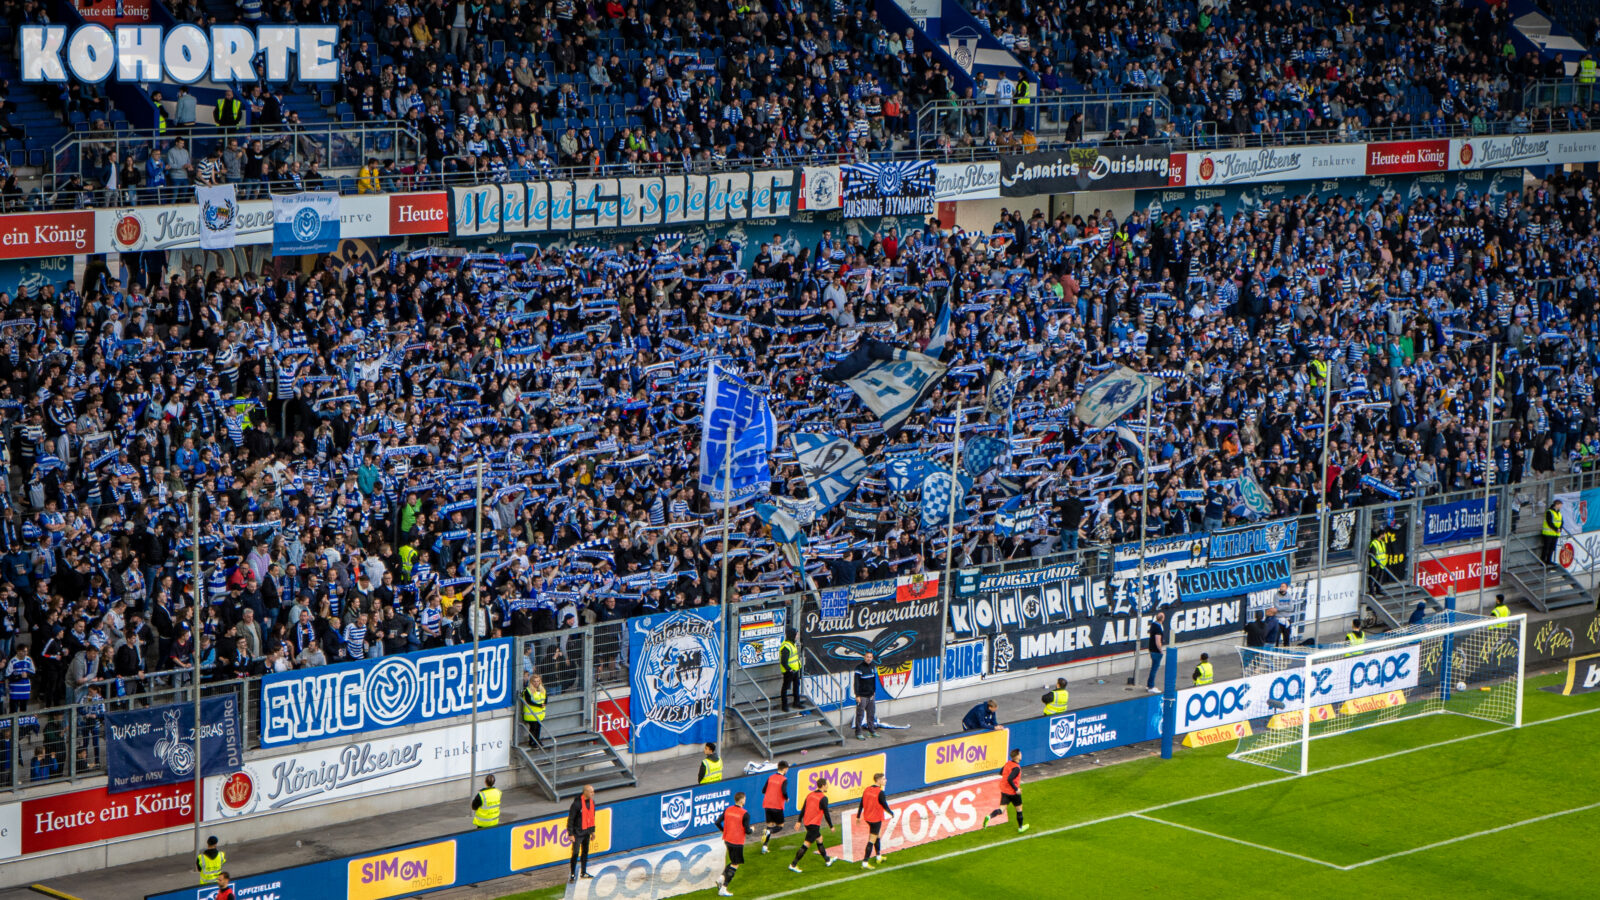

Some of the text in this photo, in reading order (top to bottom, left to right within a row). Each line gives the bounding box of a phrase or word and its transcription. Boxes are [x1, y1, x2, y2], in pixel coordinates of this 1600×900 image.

[1371, 148, 1445, 167] Heute ein König
[1558, 142, 1598, 154] Fankurve
[1002, 155, 1170, 187] Fanatics Duisburg
[1311, 155, 1356, 168] Fankurve
[398, 204, 443, 223] Heute
[885, 195, 934, 216] DYNAMITES
[2, 225, 87, 250] ein König
[1428, 512, 1453, 535] Block
[1177, 556, 1291, 597] WEDAUSTADION
[1416, 570, 1448, 587] Heute
[1449, 566, 1465, 582] ein
[951, 579, 1109, 634] KOHORTE
[1309, 589, 1356, 605] Fnkurve
[805, 600, 939, 633] Proud Generation
[1169, 600, 1241, 634] GEBEN!
[1020, 625, 1093, 660] IMMER
[1349, 652, 1411, 694] pape
[263, 642, 511, 744] EWIG TREU
[1185, 683, 1252, 728] pape
[1353, 697, 1387, 715] Sinalco
[1077, 713, 1107, 725] OFFIZIELLER
[224, 699, 238, 767] DUISBURG
[1076, 730, 1117, 748] PARTNER
[1077, 724, 1106, 738] TEAM-
[1196, 729, 1232, 747] Sinalco
[114, 771, 164, 787] Nur der MSV
[694, 789, 730, 803] OFFIZIELLER
[35, 804, 95, 835] Heute
[99, 801, 129, 822] ein
[134, 789, 193, 818] König
[694, 800, 730, 816] TEAM-
[881, 789, 978, 850] ZOXS
[237, 881, 282, 897] OFFIZIELLER
[412, 873, 443, 889] mobile
